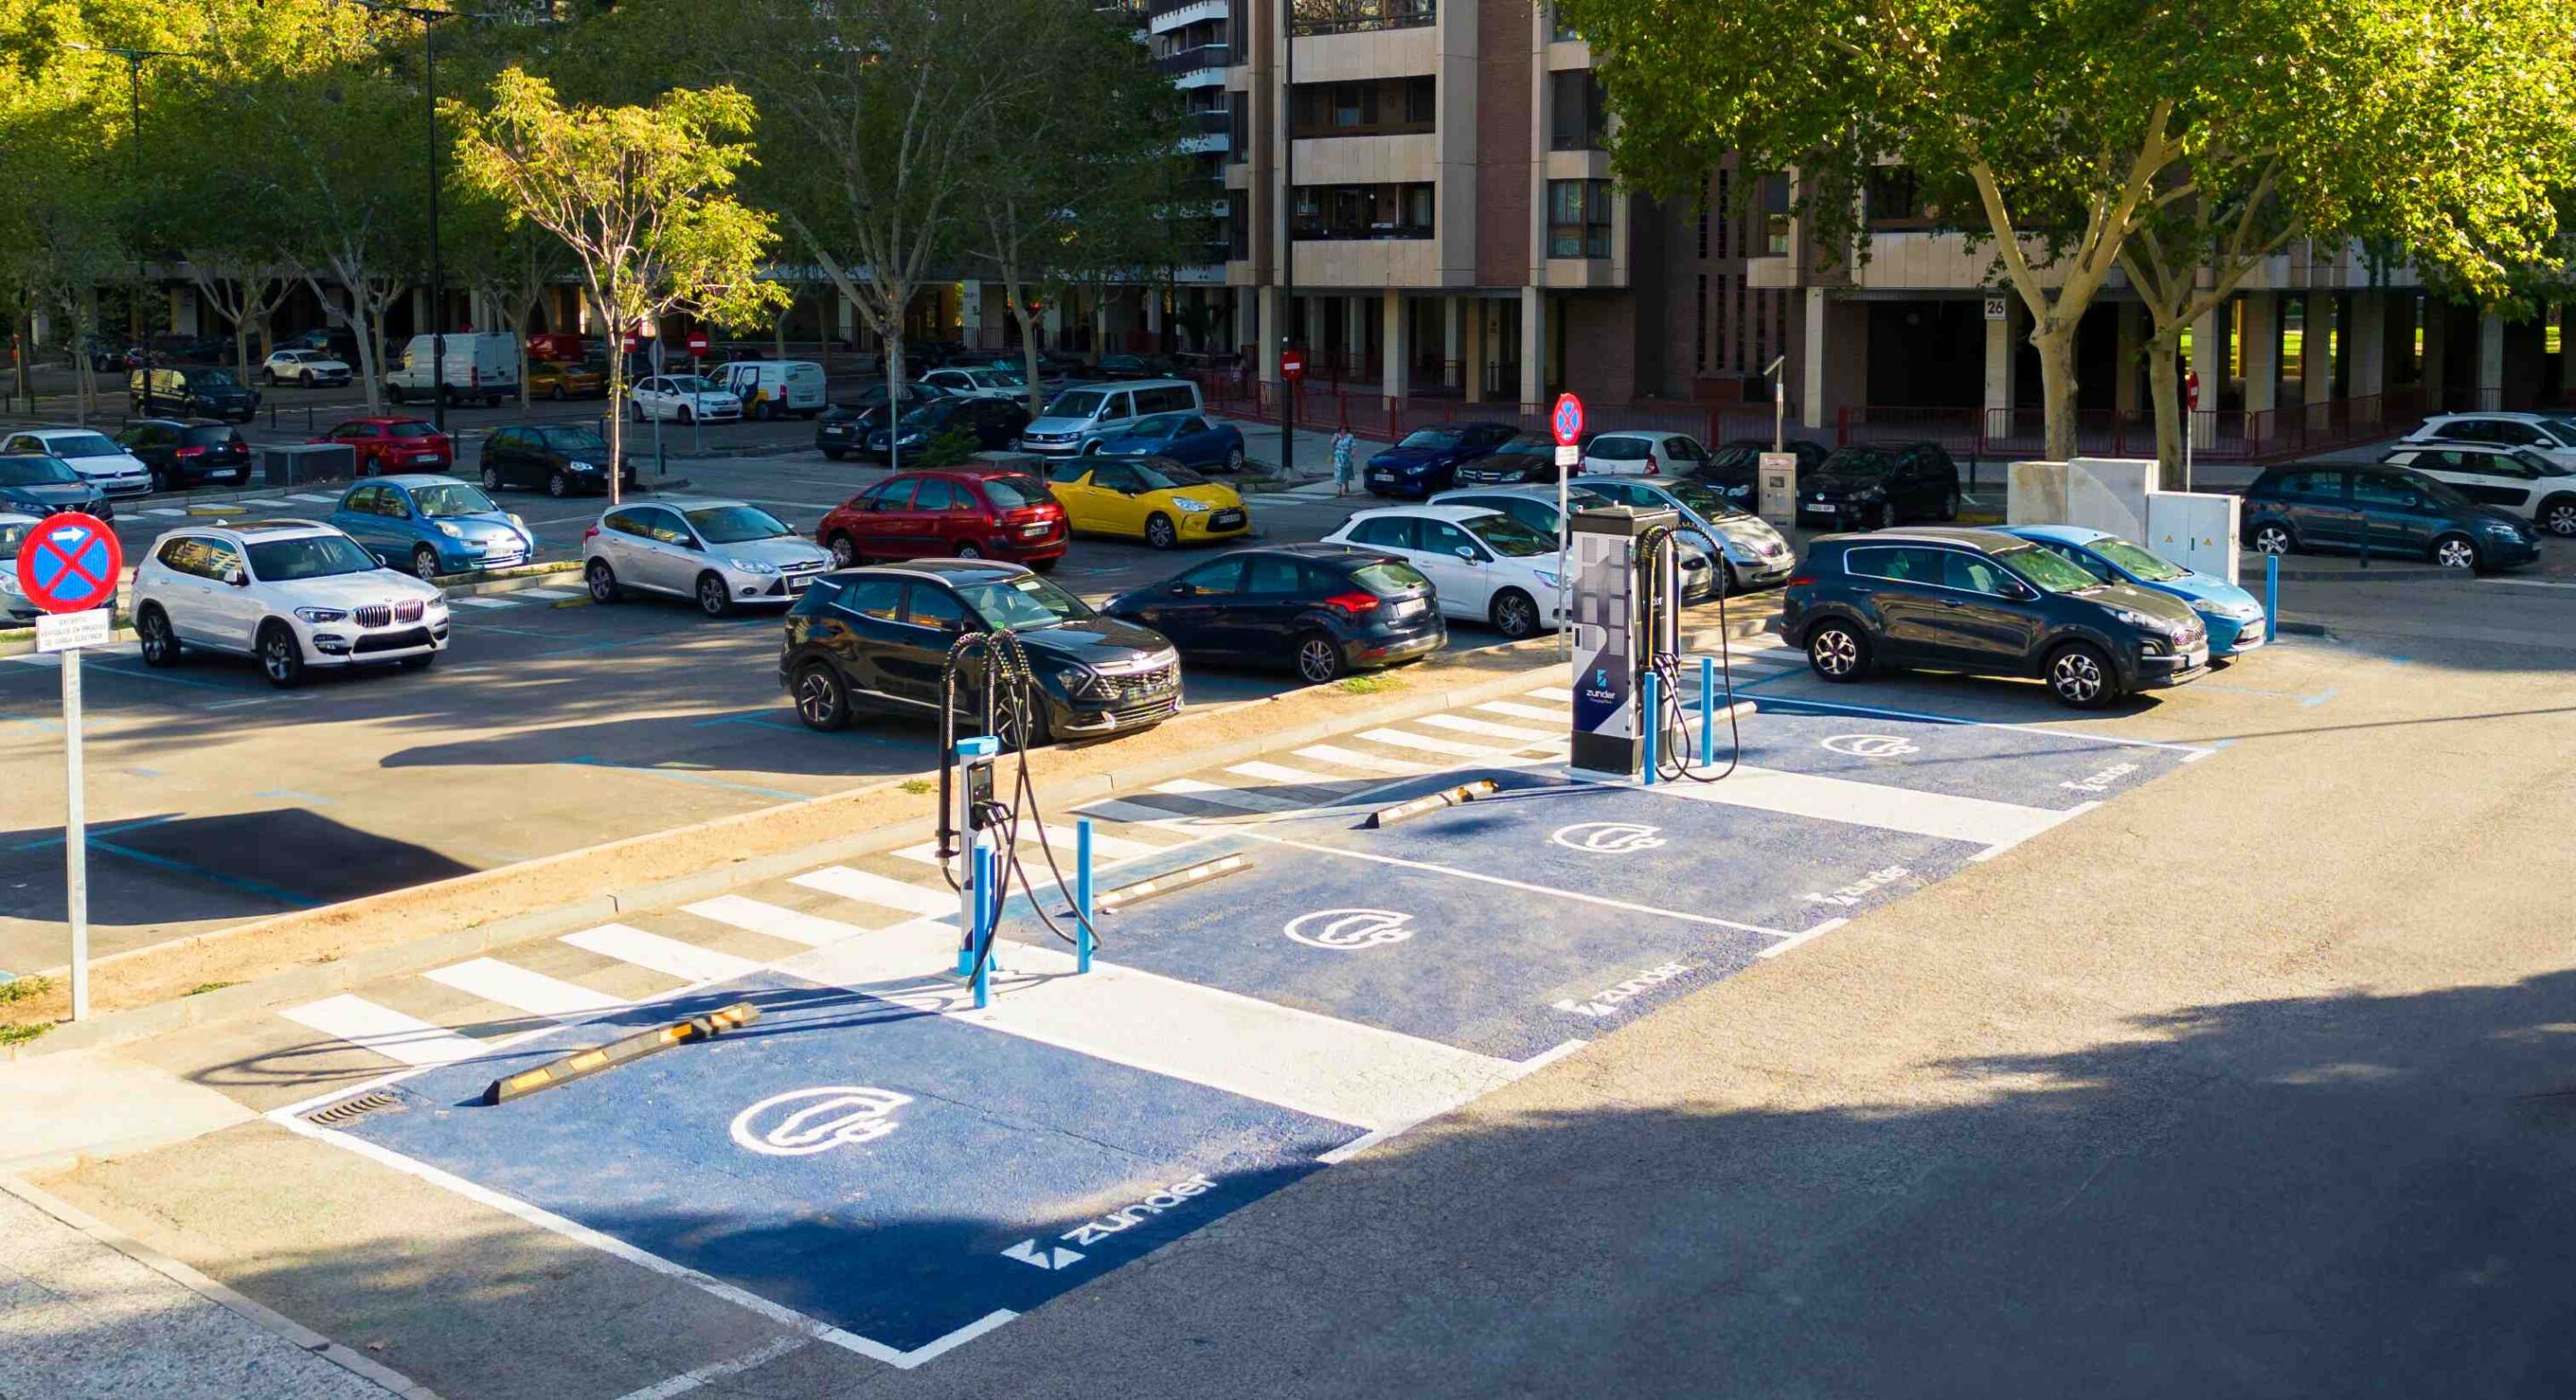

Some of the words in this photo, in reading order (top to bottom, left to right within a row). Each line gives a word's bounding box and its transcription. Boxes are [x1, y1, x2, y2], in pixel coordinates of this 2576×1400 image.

[1987, 301, 2004, 314] 26
[1586, 690, 1616, 700] zunder
[1060, 1173, 1217, 1246] zunder
